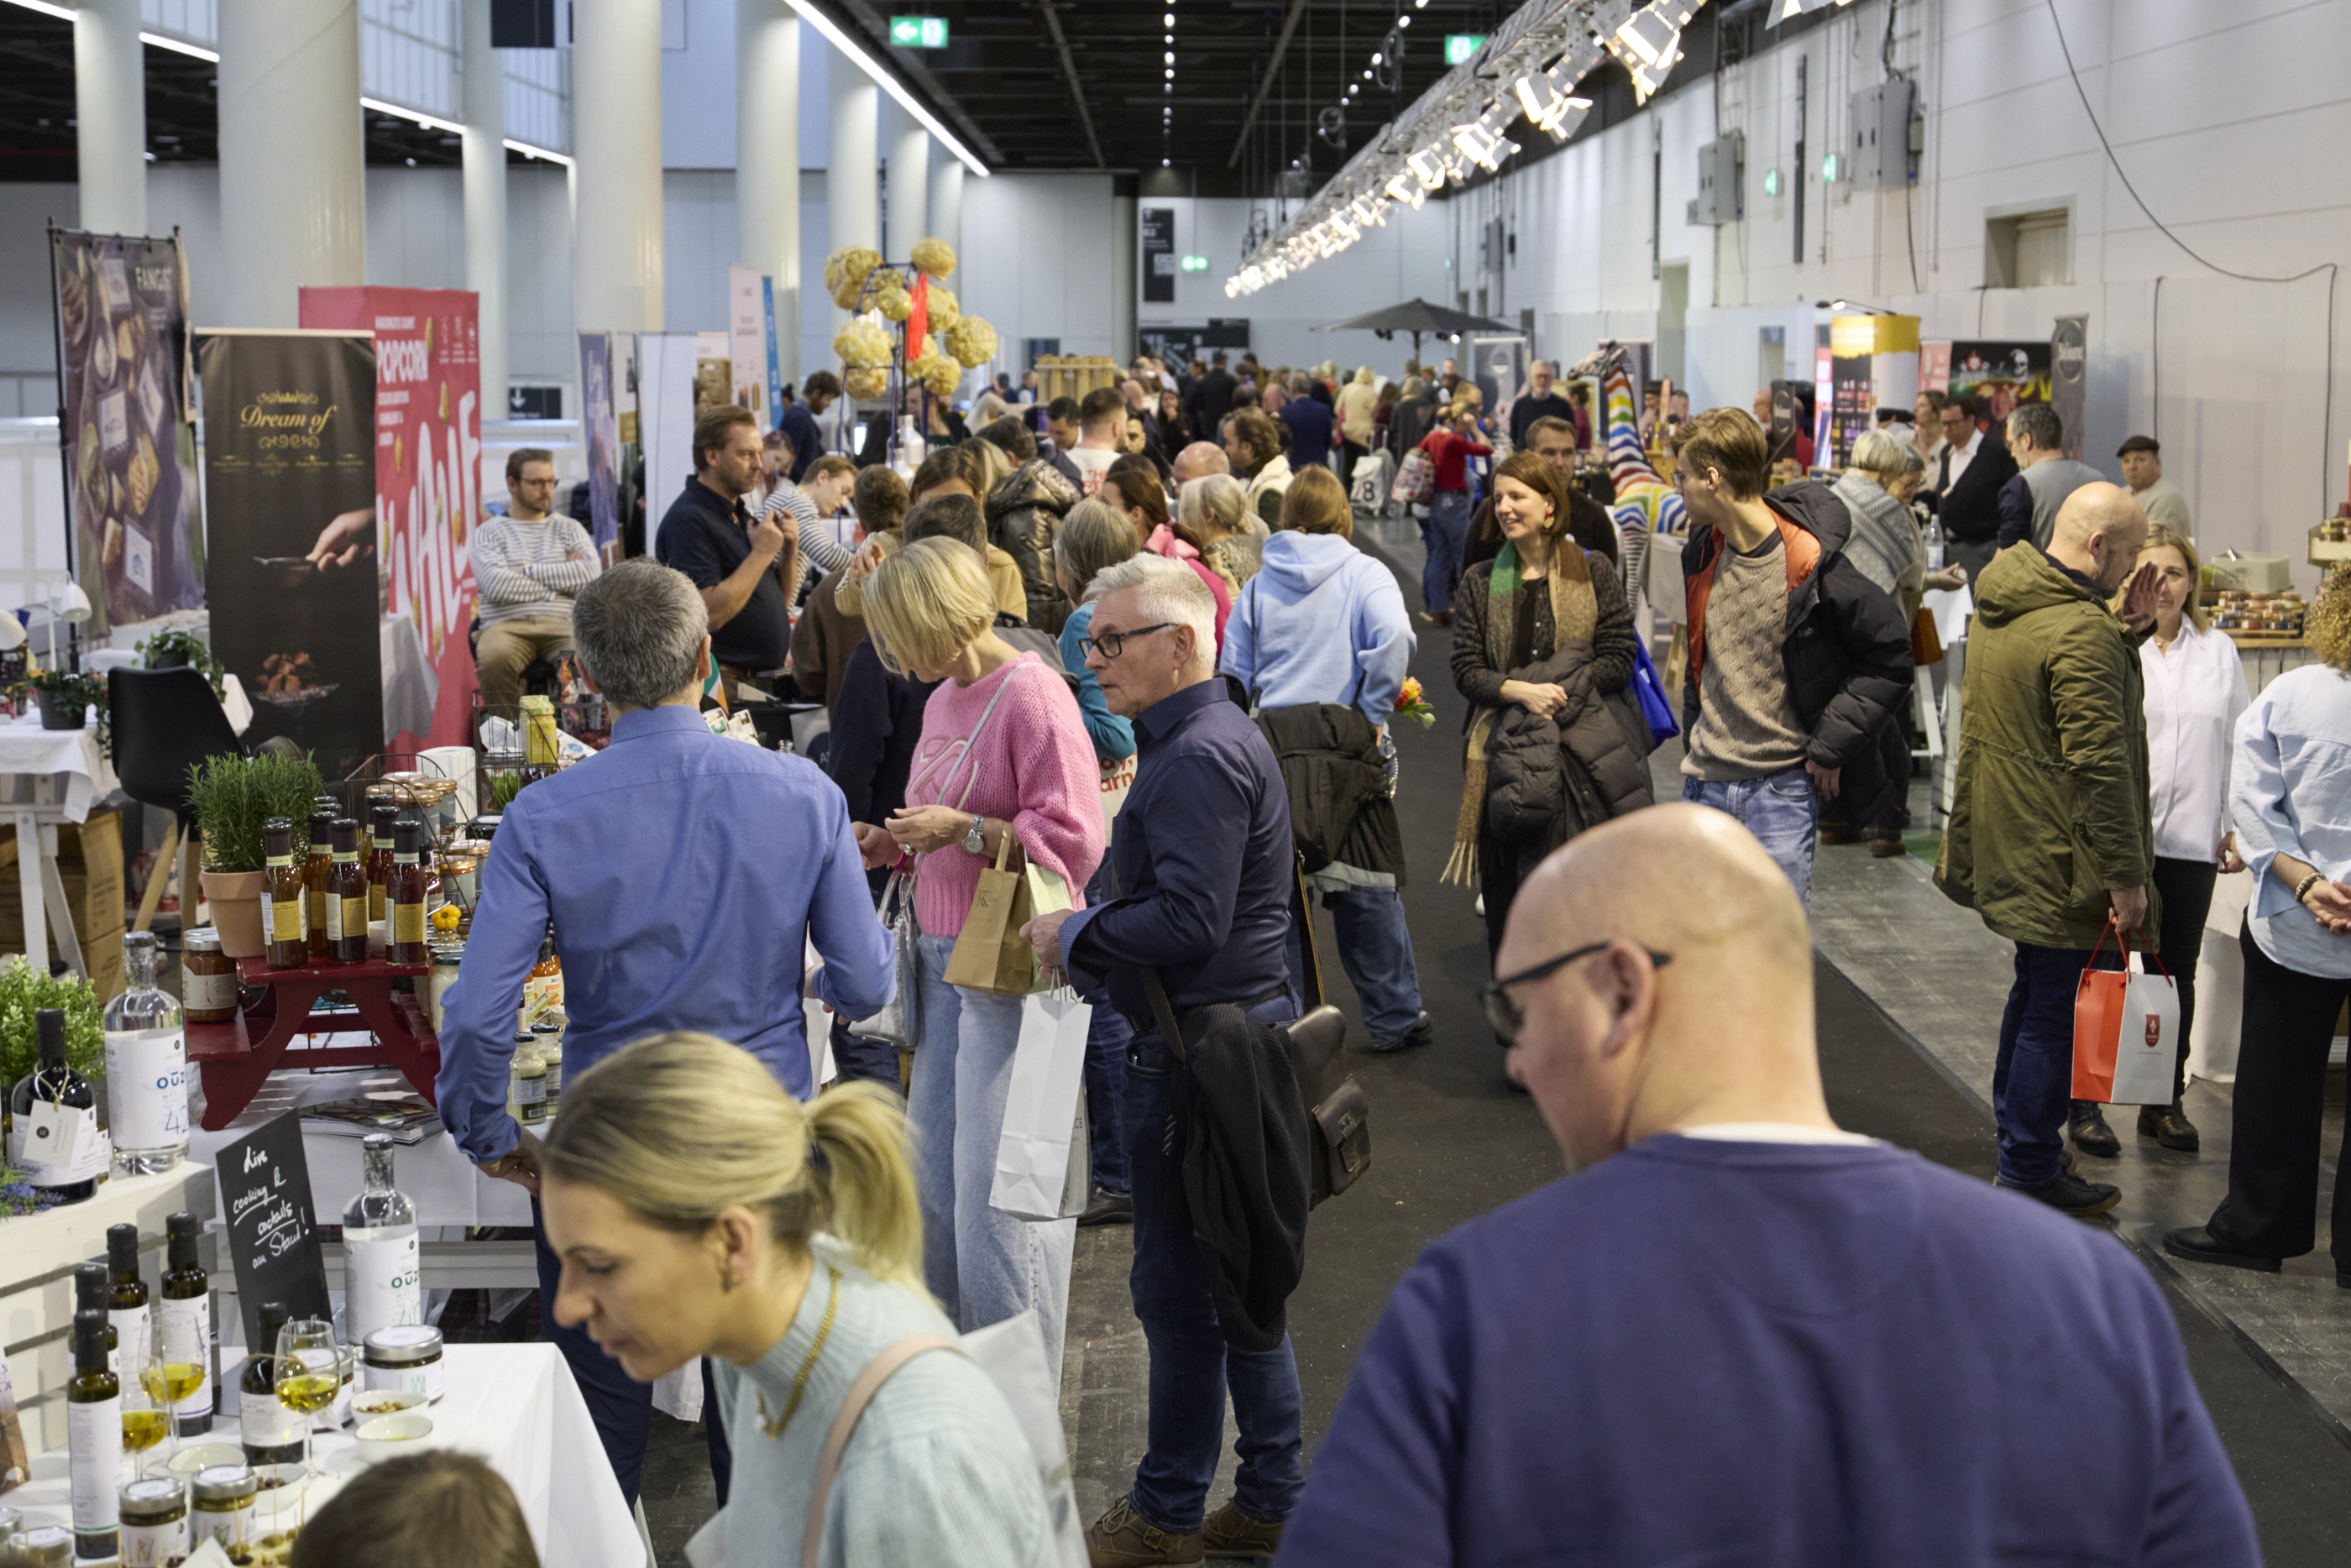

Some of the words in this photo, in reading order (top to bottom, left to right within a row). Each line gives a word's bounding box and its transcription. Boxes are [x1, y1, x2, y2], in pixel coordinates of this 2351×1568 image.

[375, 339, 428, 384] POPCORN
[239, 404, 306, 429] Dream
[307, 405, 338, 436] of
[243, 1145, 268, 1173] Live
[233, 1185, 269, 1215] cooking
[273, 1166, 287, 1188] &
